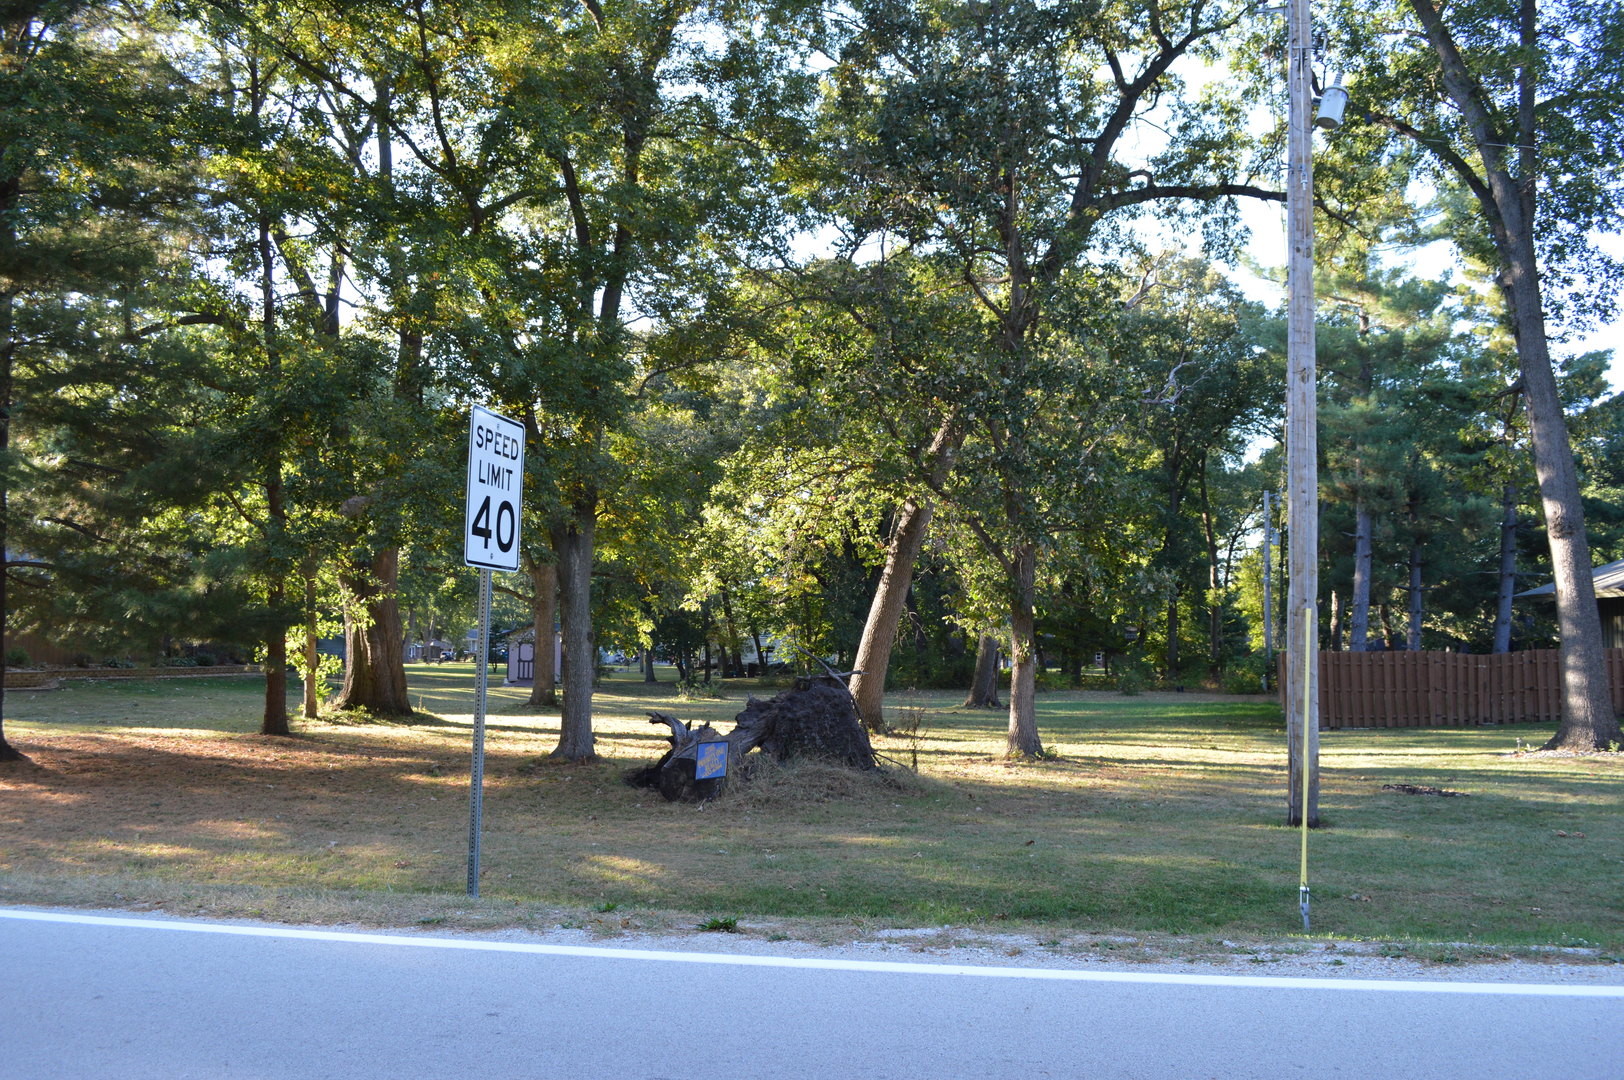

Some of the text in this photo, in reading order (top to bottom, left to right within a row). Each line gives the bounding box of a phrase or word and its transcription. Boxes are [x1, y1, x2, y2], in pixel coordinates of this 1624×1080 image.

[476, 425, 519, 461] SPEED
[478, 460, 513, 491] LIMIT
[471, 495, 515, 553] 40
